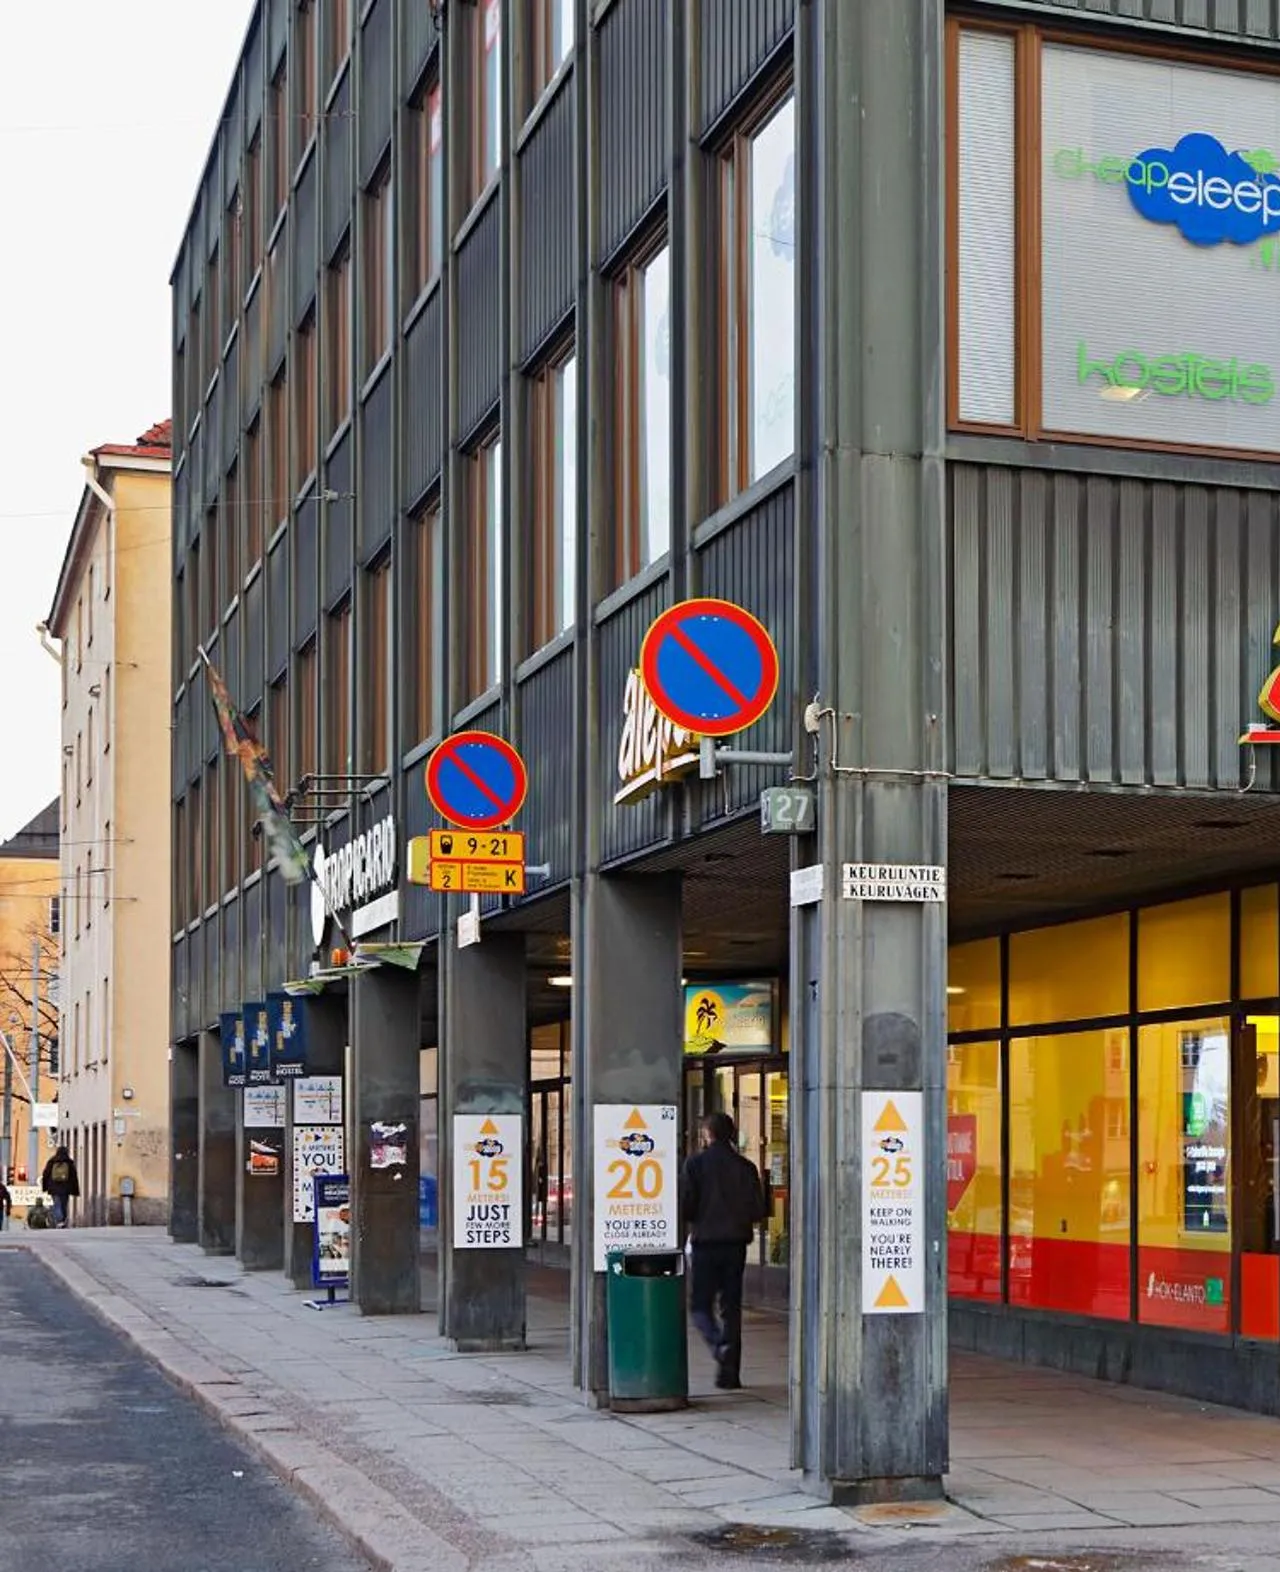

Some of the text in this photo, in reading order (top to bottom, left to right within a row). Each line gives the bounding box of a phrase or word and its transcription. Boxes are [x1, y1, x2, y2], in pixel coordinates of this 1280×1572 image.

[1076, 338, 1276, 405] hostels
[776, 794, 809, 822] 27
[442, 874, 451, 888] 2
[505, 869, 517, 887] K
[849, 866, 940, 882] KEURUUNTIE
[302, 1153, 336, 1166] YOU
[468, 1160, 508, 1191] 15
[606, 1158, 664, 1199] 20
[870, 1156, 912, 1187] 25
[467, 1204, 511, 1221] JUST
[870, 1207, 912, 1217] KEEP ON
[465, 1221, 511, 1229] FEW MORE
[650, 1219, 667, 1230] SO
[870, 1218, 912, 1226] WALKING
[467, 1230, 511, 1243] STEPS
[870, 1245, 911, 1256] NEARLY
[871, 1257, 913, 1269] THERE!
